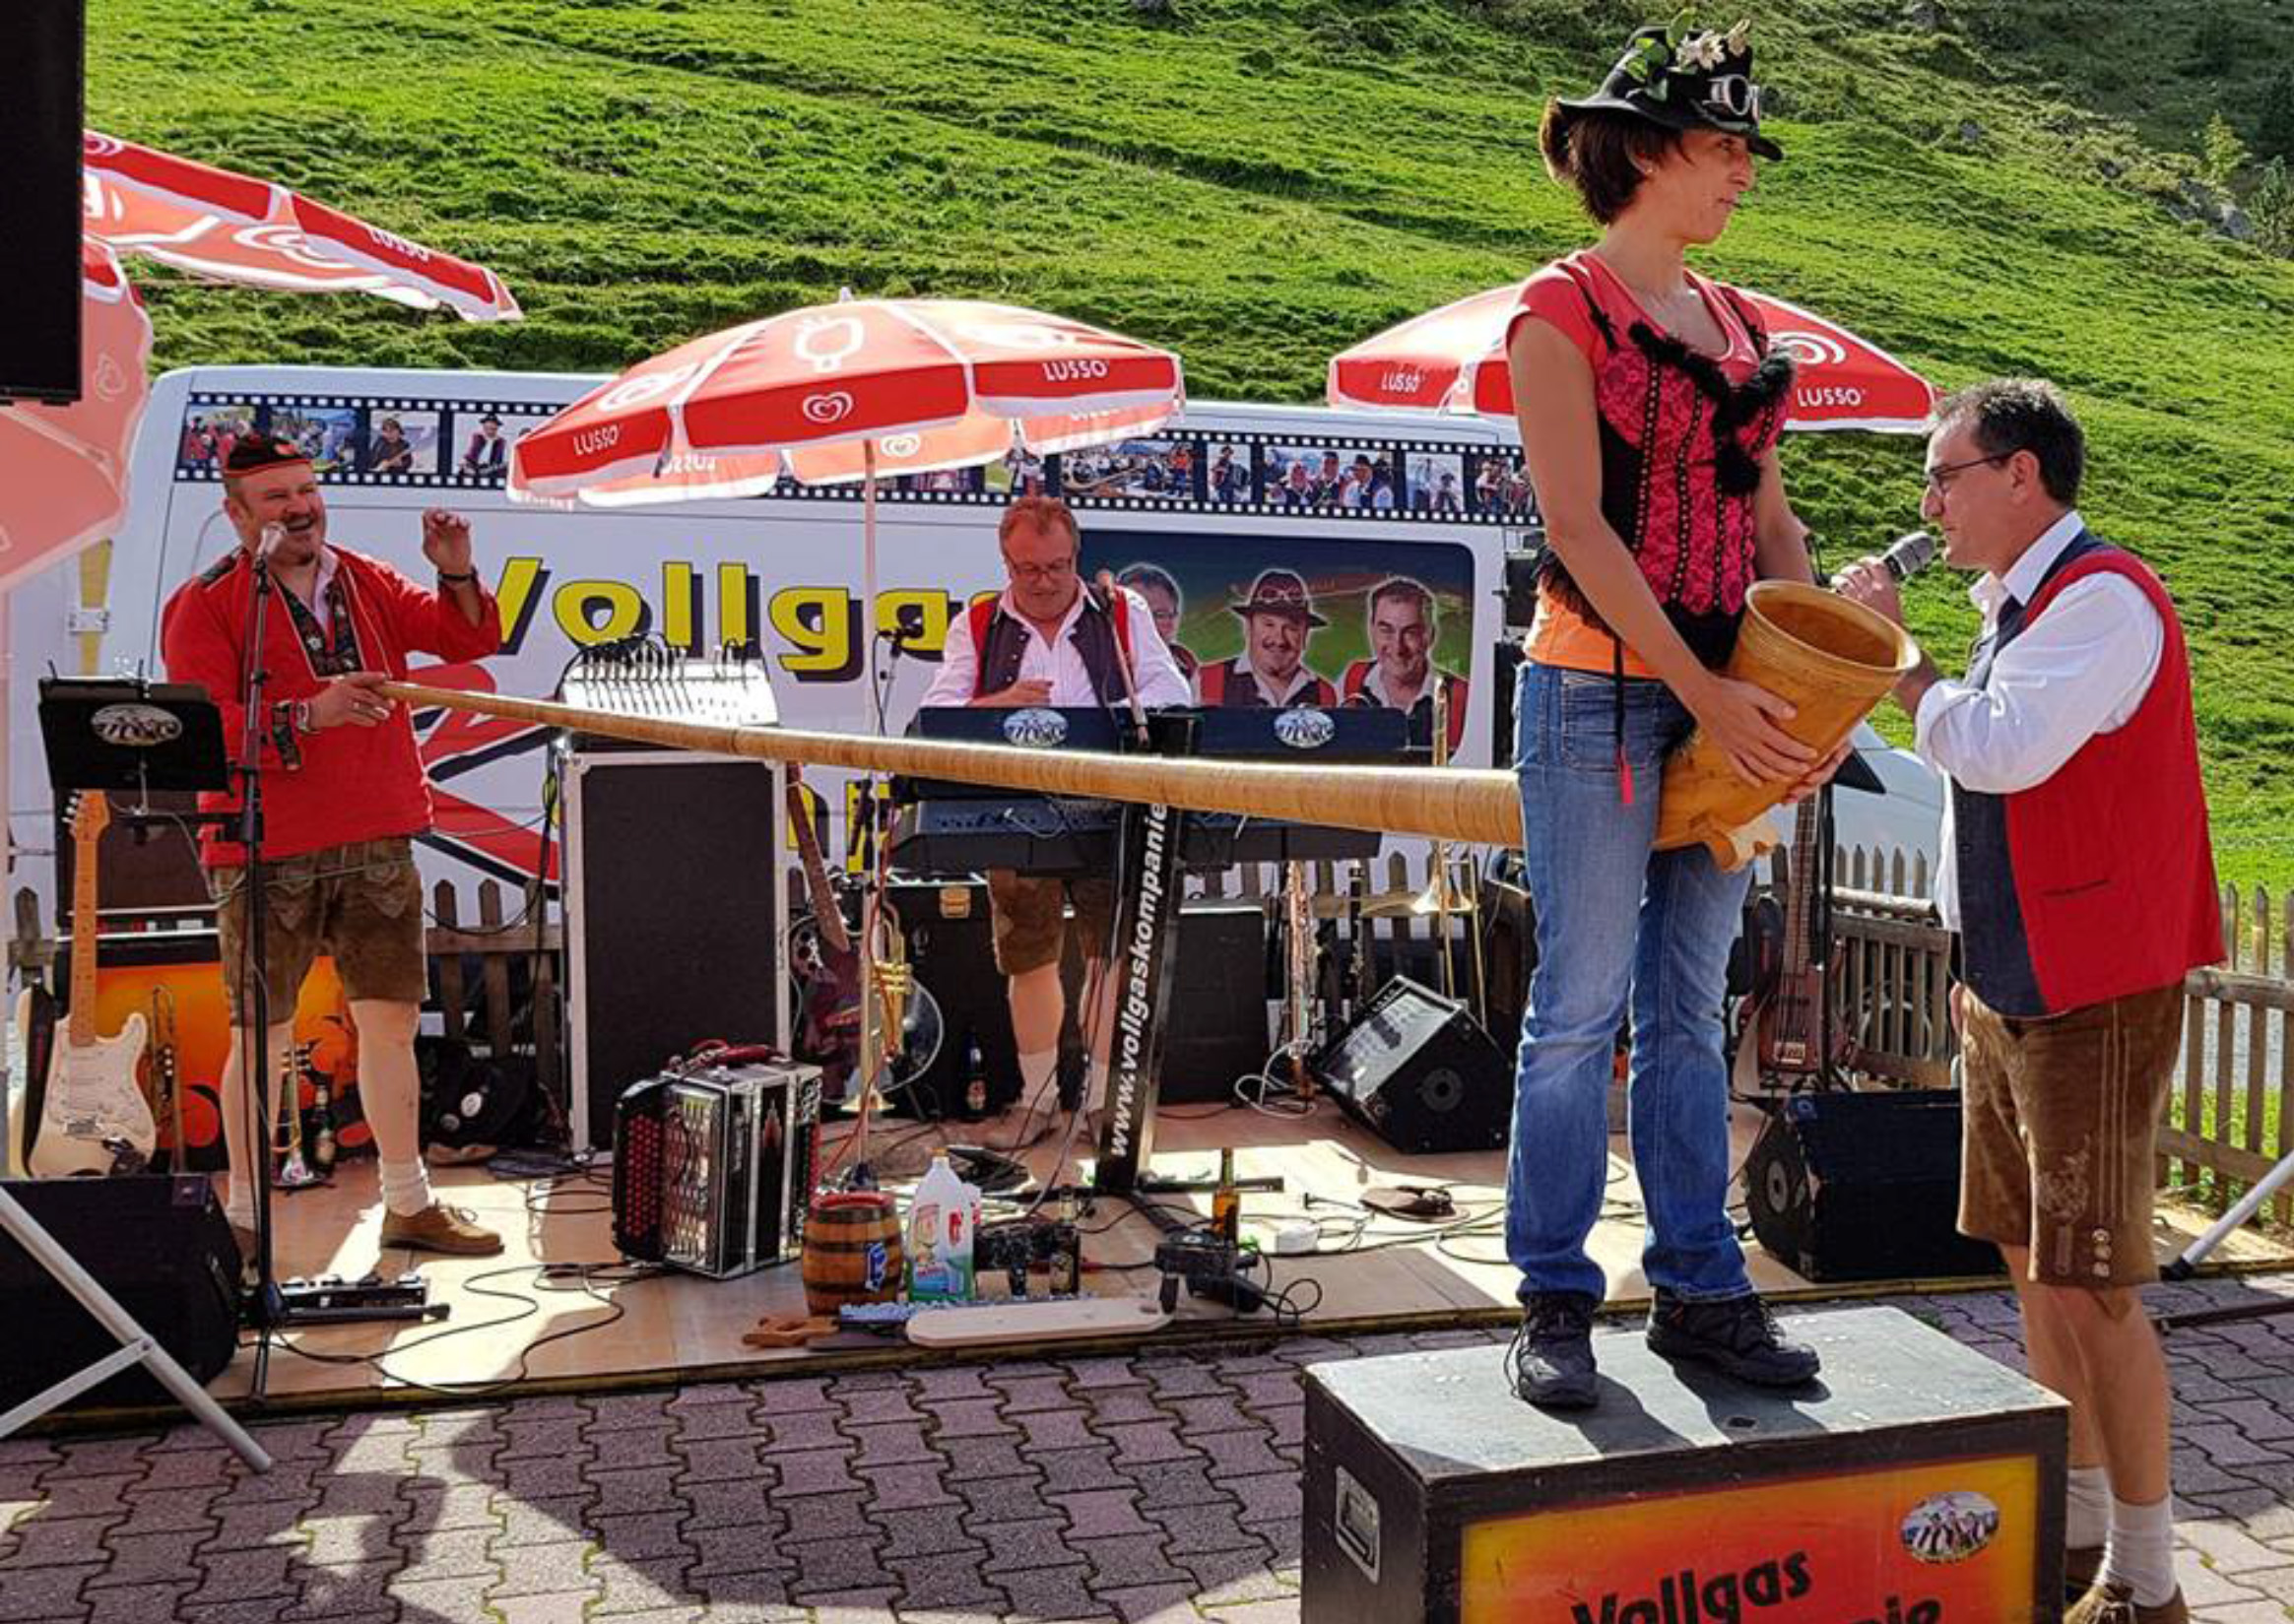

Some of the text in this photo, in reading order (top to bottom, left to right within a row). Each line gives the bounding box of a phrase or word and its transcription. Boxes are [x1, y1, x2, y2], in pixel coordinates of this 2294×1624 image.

[1042, 358, 1108, 382] LUSSO
[1381, 371, 1420, 393] LUSSO
[1797, 386, 1863, 408] LUSSO
[572, 423, 622, 456] LUSSO
[495, 556, 1002, 682] ollga
[1110, 802, 1170, 1158] www.vollgaskompanie
